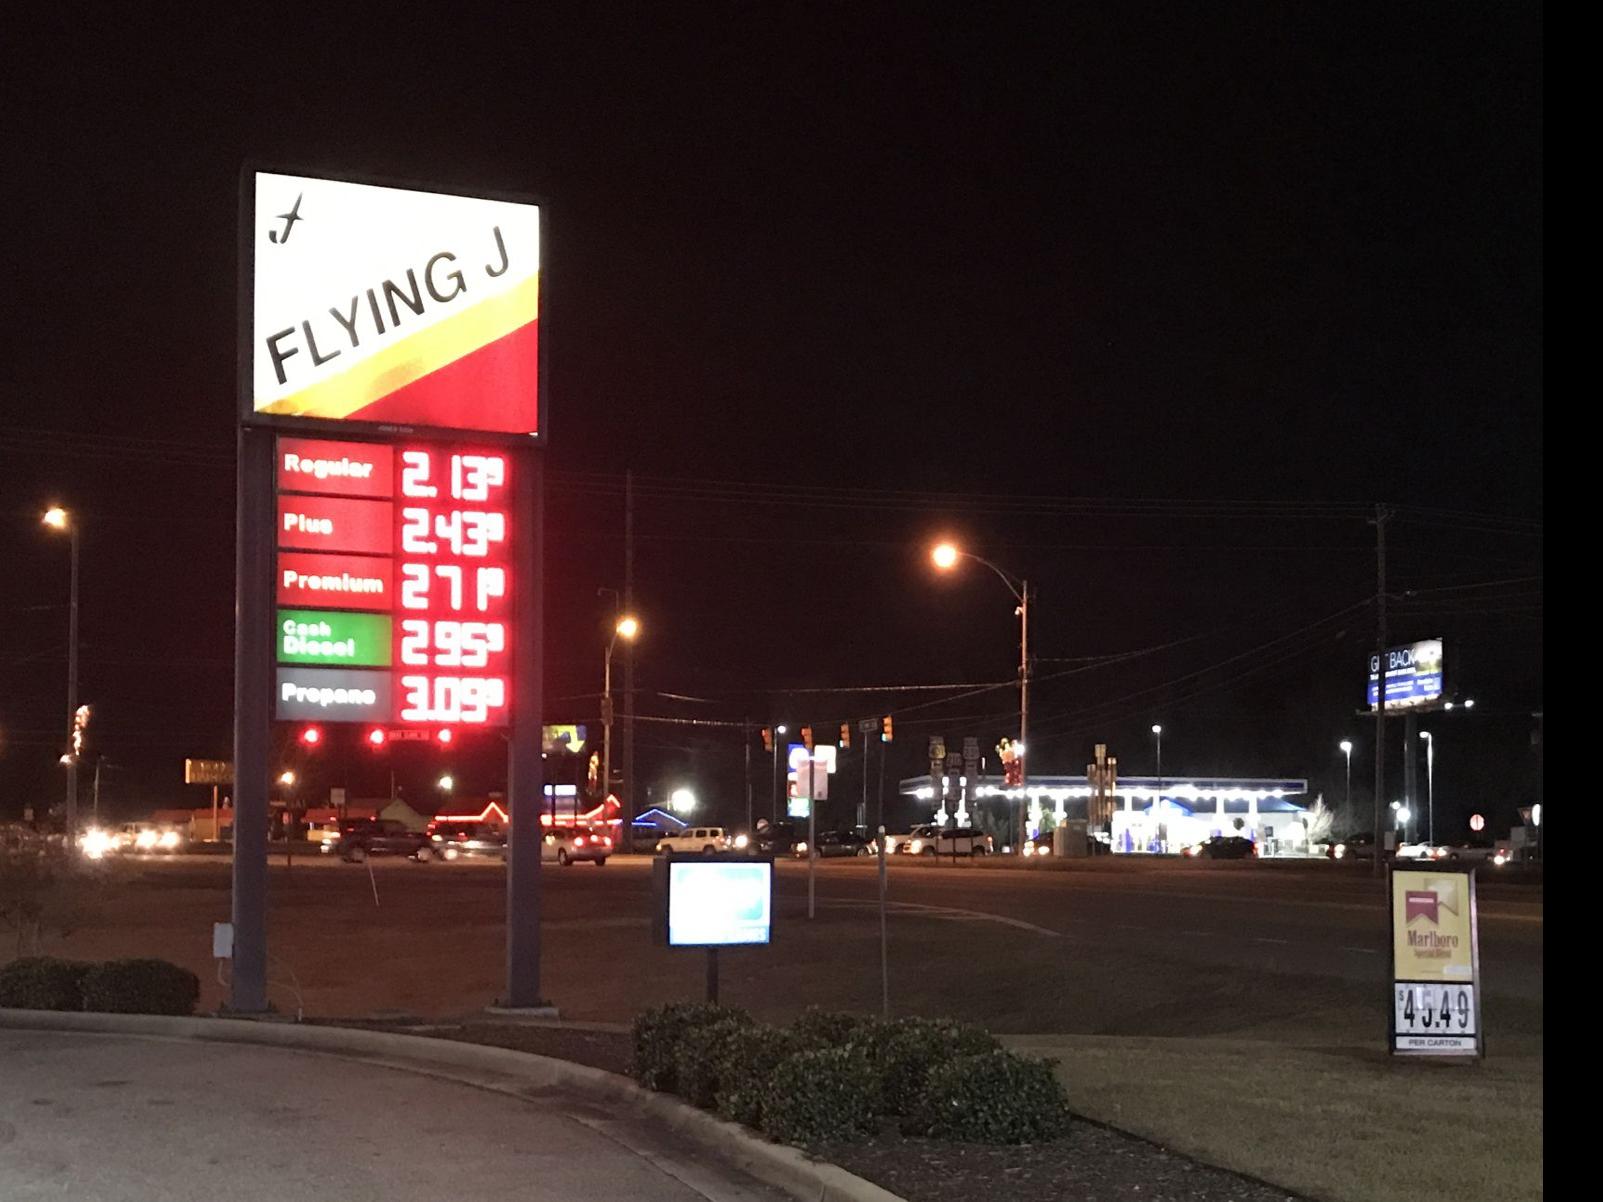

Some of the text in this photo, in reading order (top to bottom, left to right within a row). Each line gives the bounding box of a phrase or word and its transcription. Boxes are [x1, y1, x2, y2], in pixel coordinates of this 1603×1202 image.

[266, 226, 510, 385] FLYING J
[284, 454, 373, 479] Regular
[284, 513, 333, 534] Plus
[284, 571, 384, 593] Premium
[283, 620, 331, 637] Cash
[284, 635, 356, 657] Diesel
[1390, 648, 1416, 668] BACK
[282, 683, 377, 707] Propane
[1408, 931, 1458, 948] Marlboro
[1408, 1039, 1462, 1047] PER CARTON
